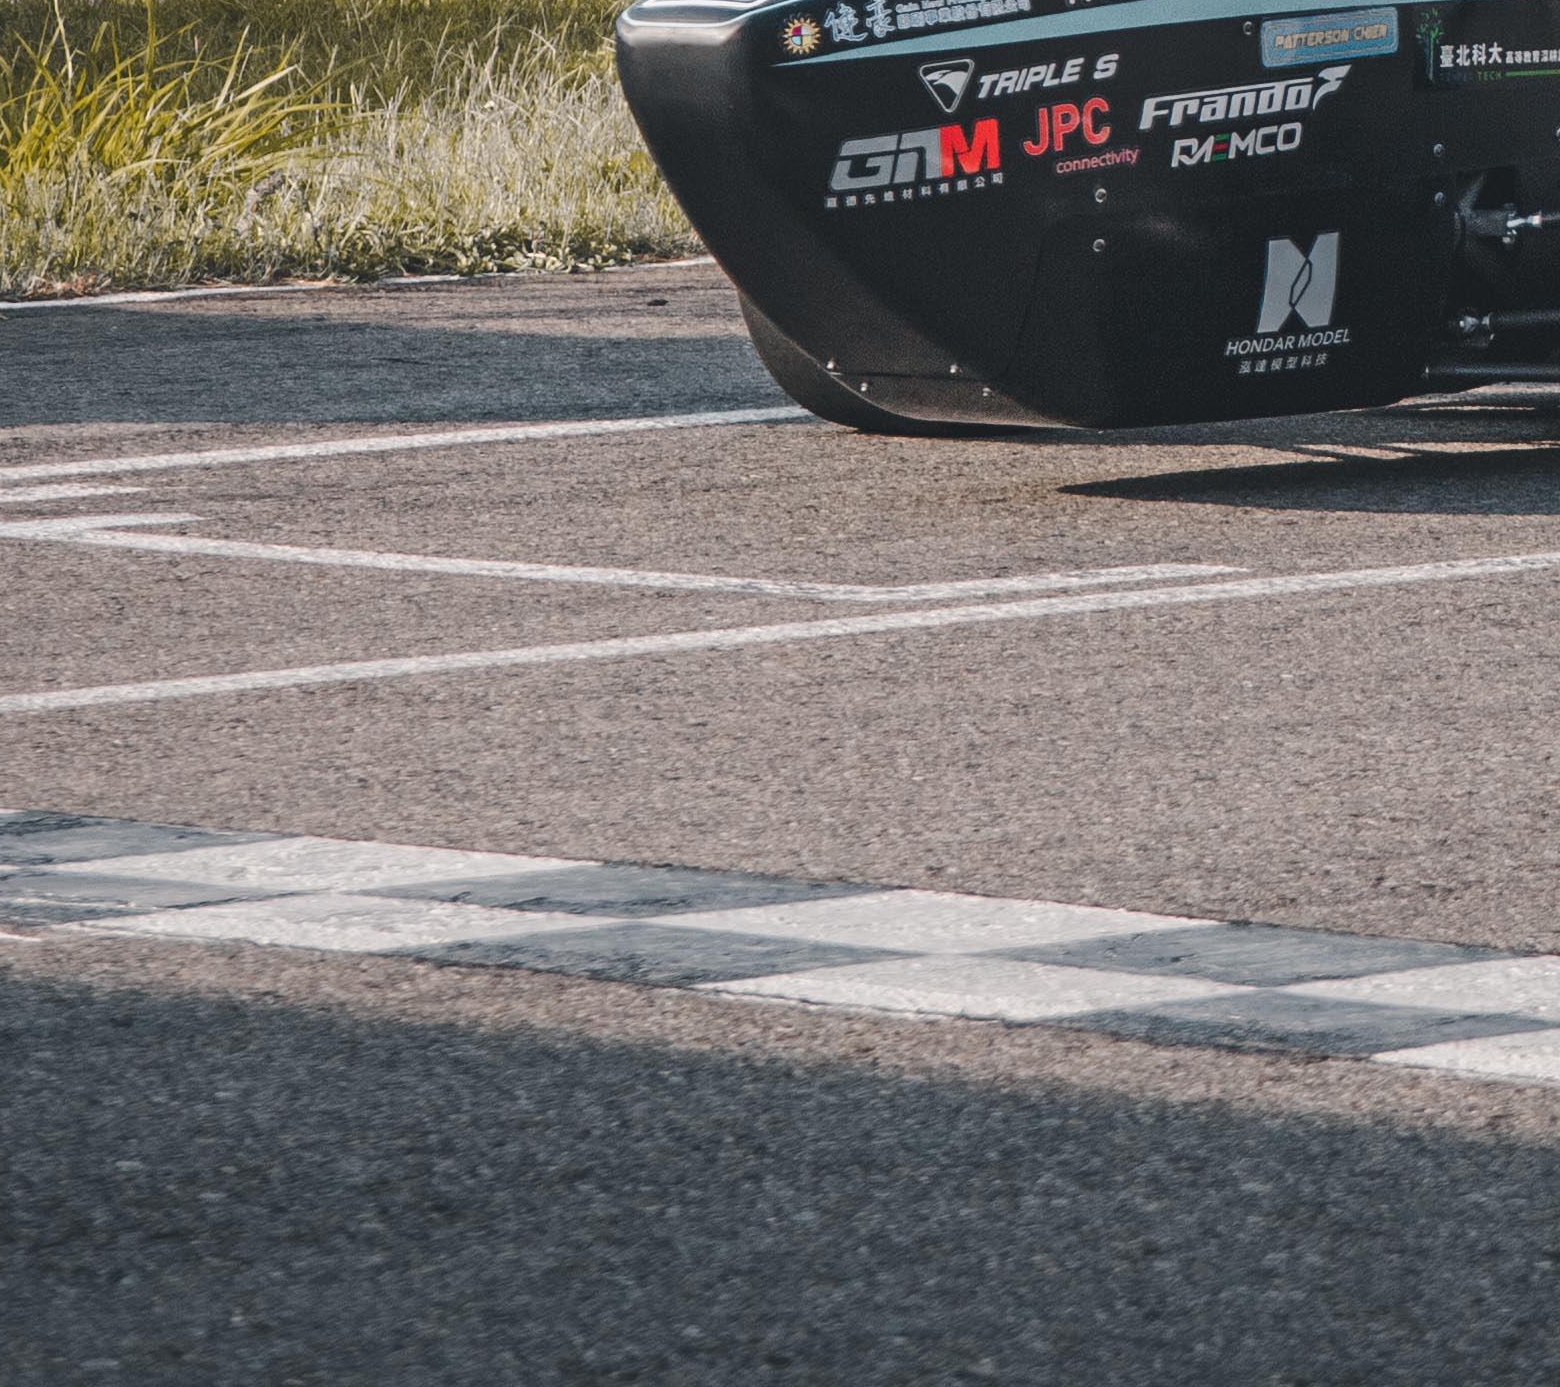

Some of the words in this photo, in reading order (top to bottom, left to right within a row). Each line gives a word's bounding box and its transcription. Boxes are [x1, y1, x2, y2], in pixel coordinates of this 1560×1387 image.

[1274, 27, 1350, 50] PATTERSON
[1439, 41, 1503, 68] 臺北科大
[977, 57, 1085, 99] TRIPLE
[1093, 53, 1120, 80] S
[1139, 76, 1320, 130] Frando
[1022, 96, 1111, 156] JPC
[1056, 147, 1140, 175] connectivity
[1225, 335, 1295, 356] HONDAR
[1297, 328, 1351, 348] MODEL
